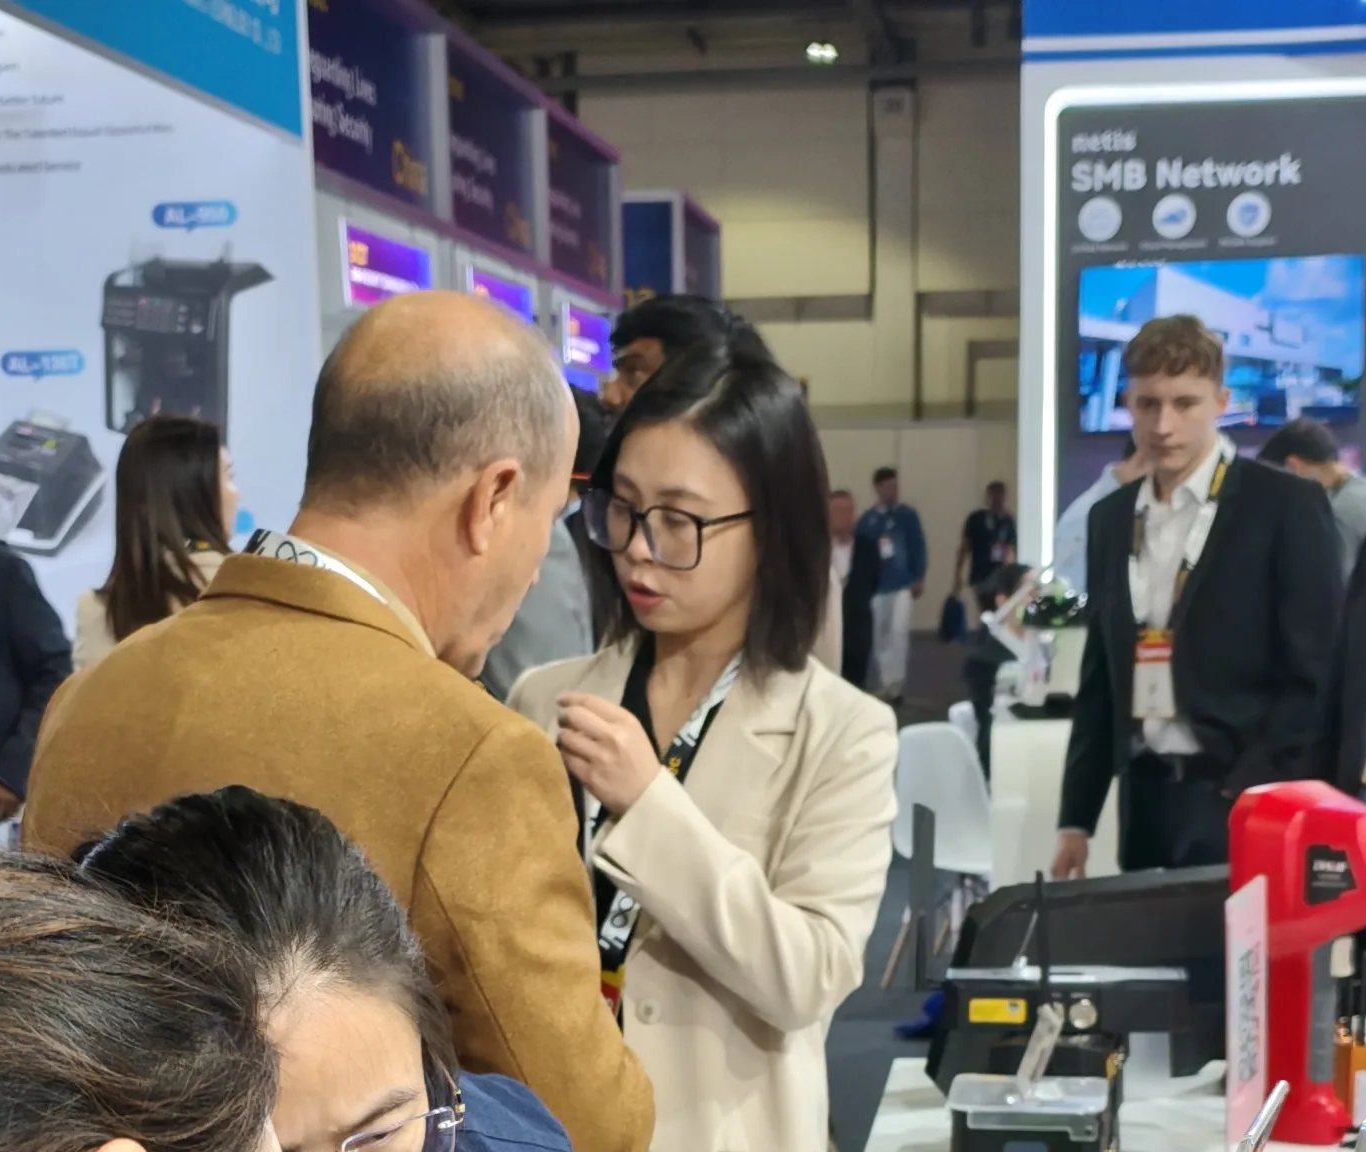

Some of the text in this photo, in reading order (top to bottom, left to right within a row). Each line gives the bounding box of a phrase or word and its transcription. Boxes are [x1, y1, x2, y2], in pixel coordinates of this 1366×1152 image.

[1071, 129, 1137, 153] netis
[1071, 152, 1302, 193] SMB Network
